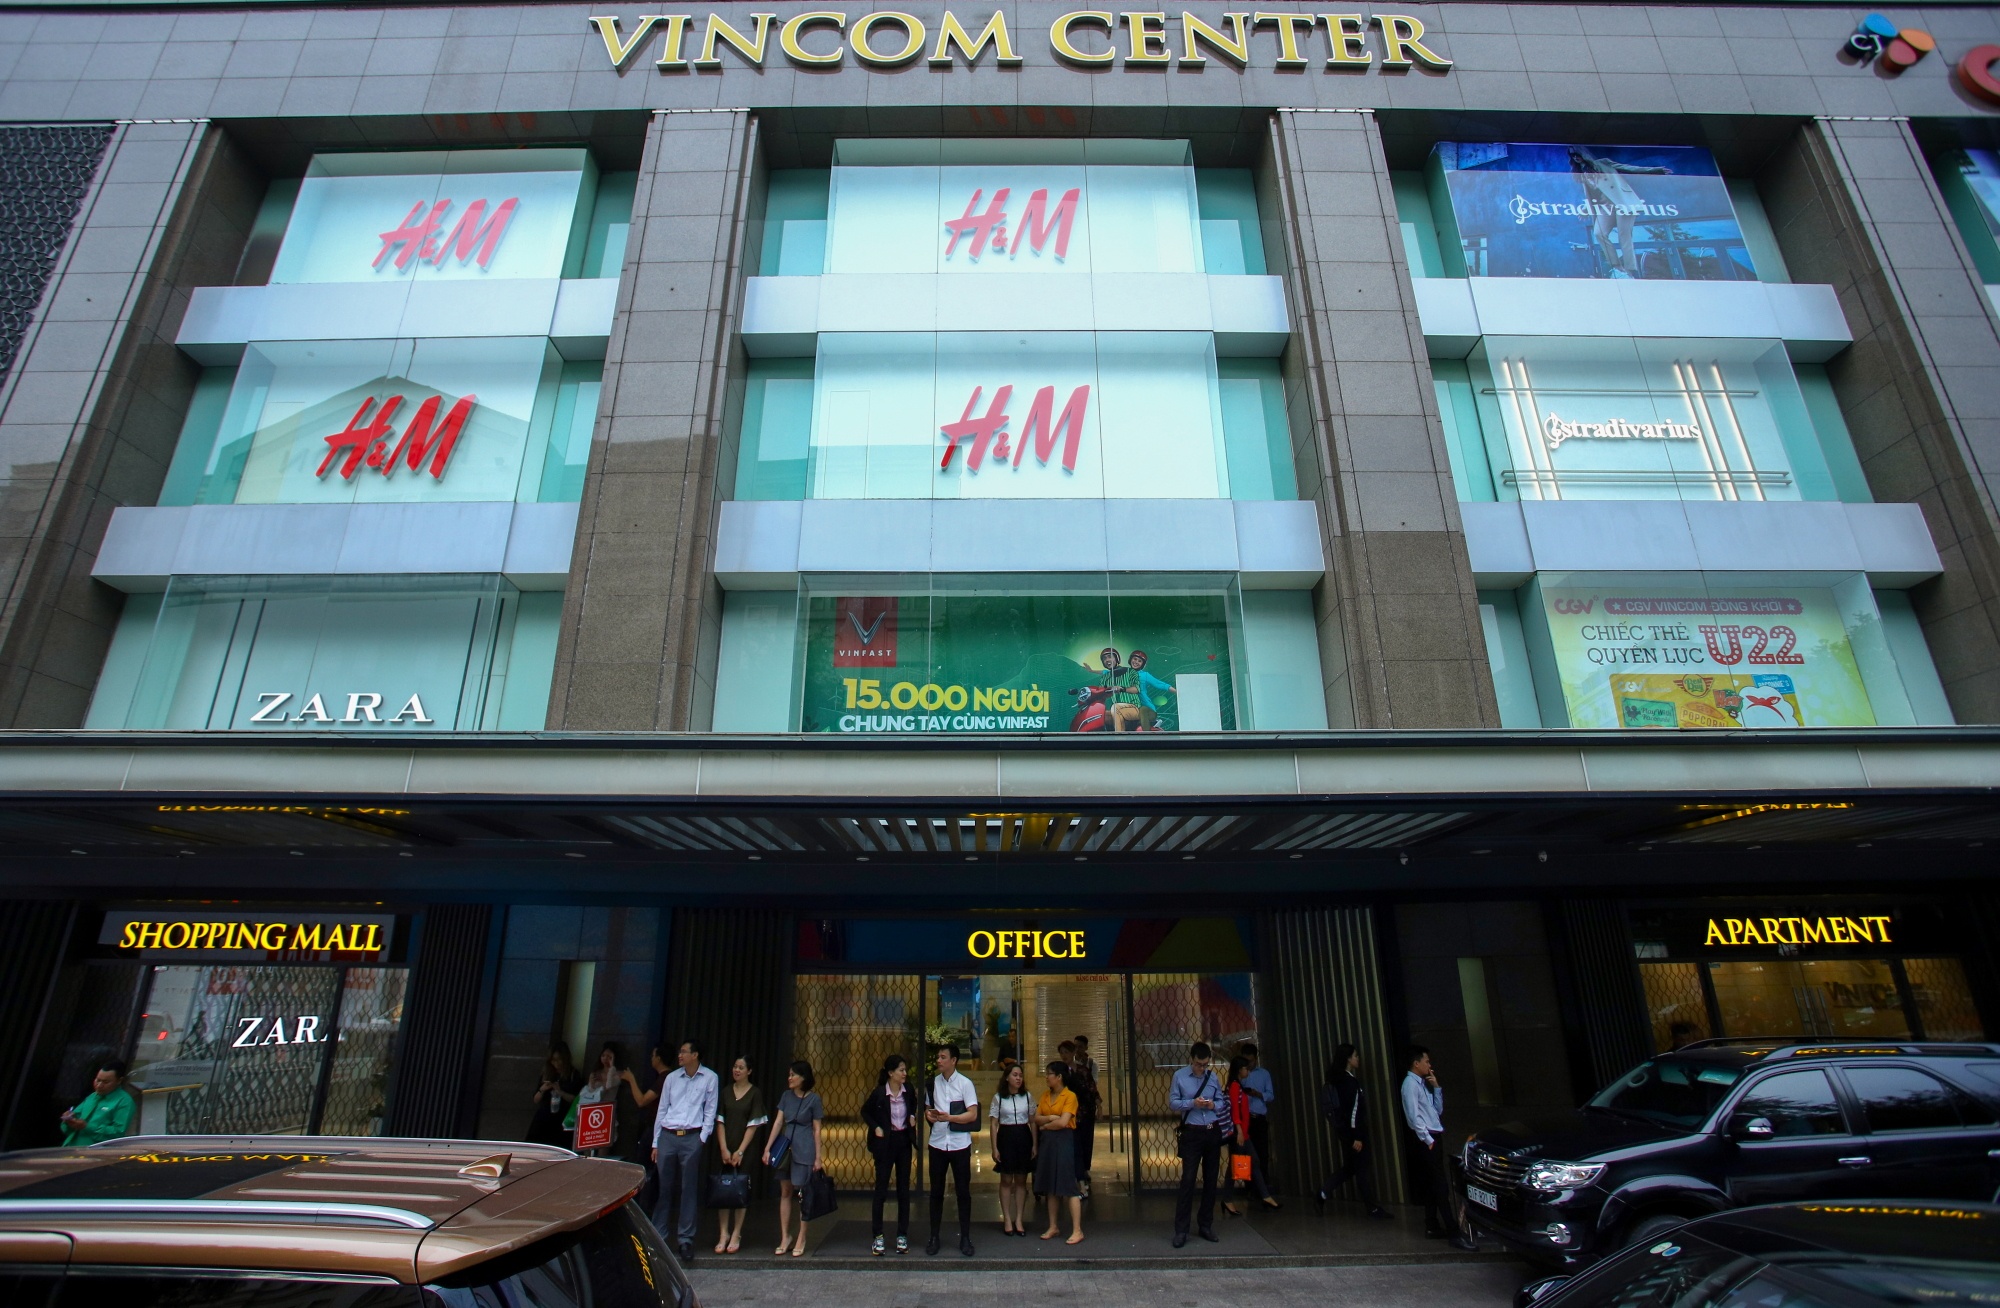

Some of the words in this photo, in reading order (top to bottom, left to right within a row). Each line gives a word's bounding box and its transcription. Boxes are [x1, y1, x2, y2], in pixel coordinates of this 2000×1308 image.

[588, 10, 1024, 68] VINCOM
[1049, 10, 1454, 68] CENTER
[1528, 198, 1679, 217] stradivarius
[371, 197, 520, 270] H&M
[944, 187, 1081, 260] H&M
[315, 393, 478, 481] H&M
[940, 384, 1091, 473] H&M
[1561, 418, 1701, 439] stradivarius
[1554, 598, 1594, 615] CGV
[1625, 601, 1651, 612] CGV
[1654, 601, 1707, 612] VINCOM
[1581, 621, 1645, 641] CHIẾC
[1648, 621, 1690, 641] THẺ
[1698, 625, 1805, 666] U22
[839, 649, 892, 657] VINFAST
[1587, 643, 1659, 665] QUYỀN
[1662, 647, 1705, 666] LỰC
[249, 692, 434, 722] ZARA
[842, 677, 969, 711] 15.000
[973, 683, 1050, 712] NGƯỜI
[838, 714, 916, 732] CHUNG
[917, 715, 952, 731] TAY
[952, 712, 996, 730] CÙNG
[997, 716, 1050, 729] VINFAST
[1682, 709, 1726, 727] POPCORN
[119, 921, 288, 951] SHOPPING
[291, 923, 382, 951] MALL
[967, 930, 1087, 959] OFFICE
[1703, 916, 1893, 946] APARTMENT
